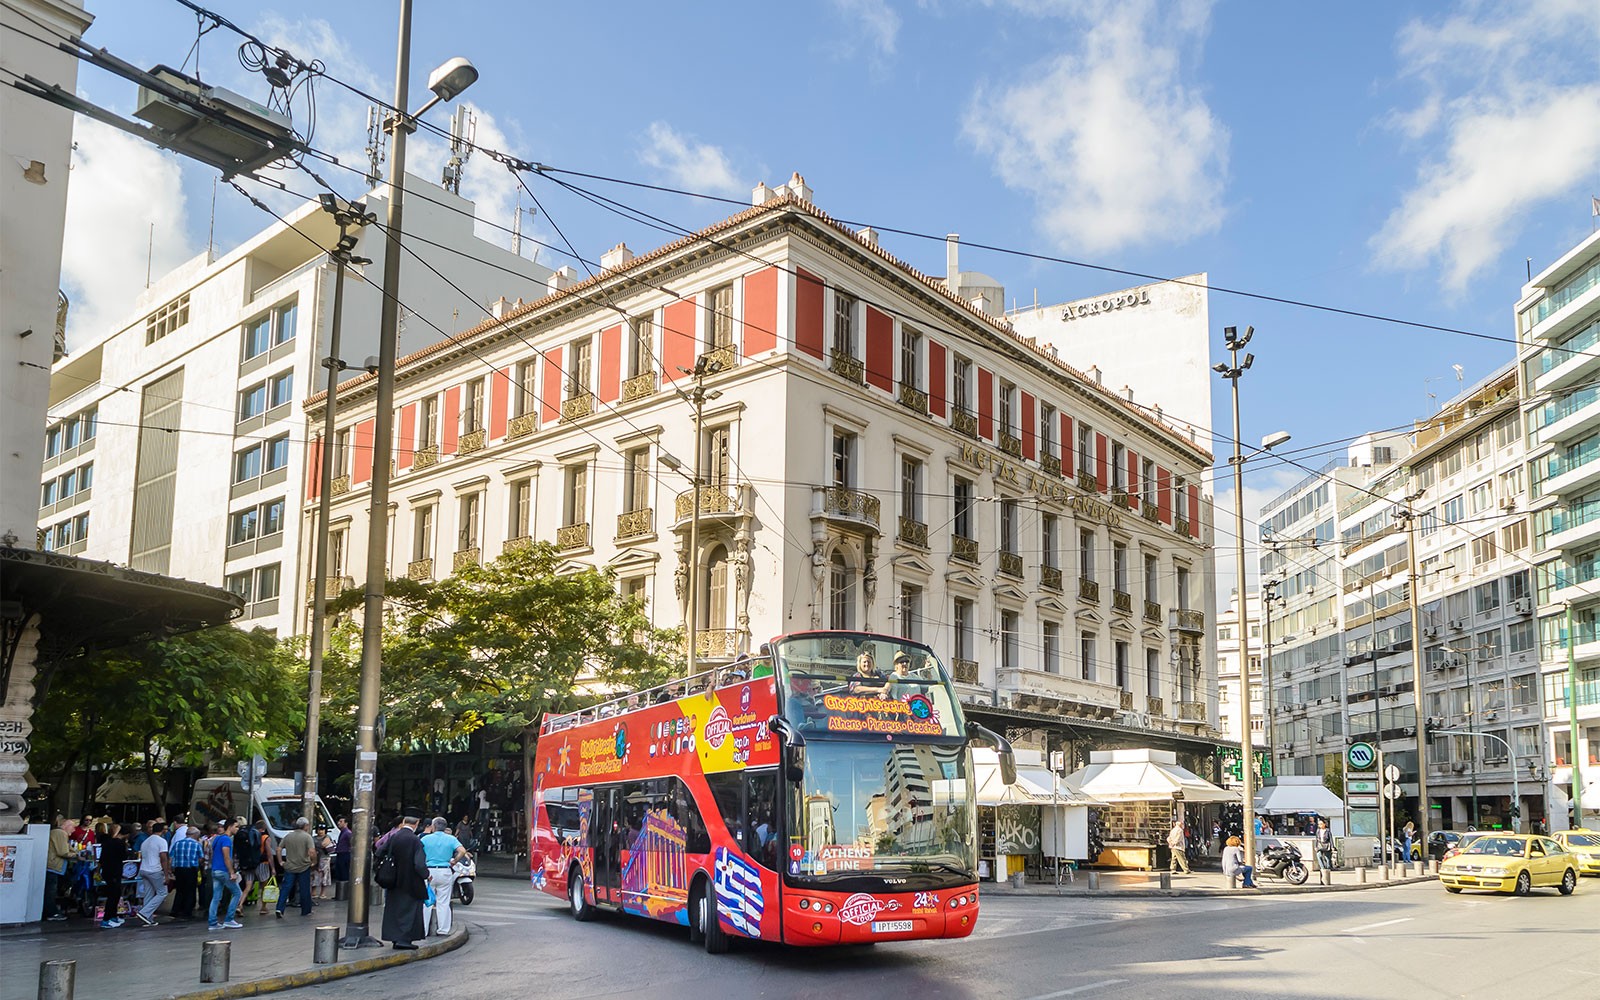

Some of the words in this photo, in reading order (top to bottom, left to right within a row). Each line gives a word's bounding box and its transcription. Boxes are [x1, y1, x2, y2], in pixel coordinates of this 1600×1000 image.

[1061, 291, 1151, 321] ACROPOL
[962, 443, 1019, 485] ΜΕΓΑΣ
[824, 694, 912, 715] CitySightseeing
[706, 721, 731, 738] OFFICIAL
[829, 717, 861, 730] Athens
[867, 717, 901, 733] Piraeus
[907, 721, 942, 735] Beaches
[793, 848, 801, 857] 10
[822, 848, 871, 859] ATHENS
[834, 861, 860, 871] LINE
[842, 901, 883, 919] OFFICIAL
[856, 913, 874, 923] TOUR
